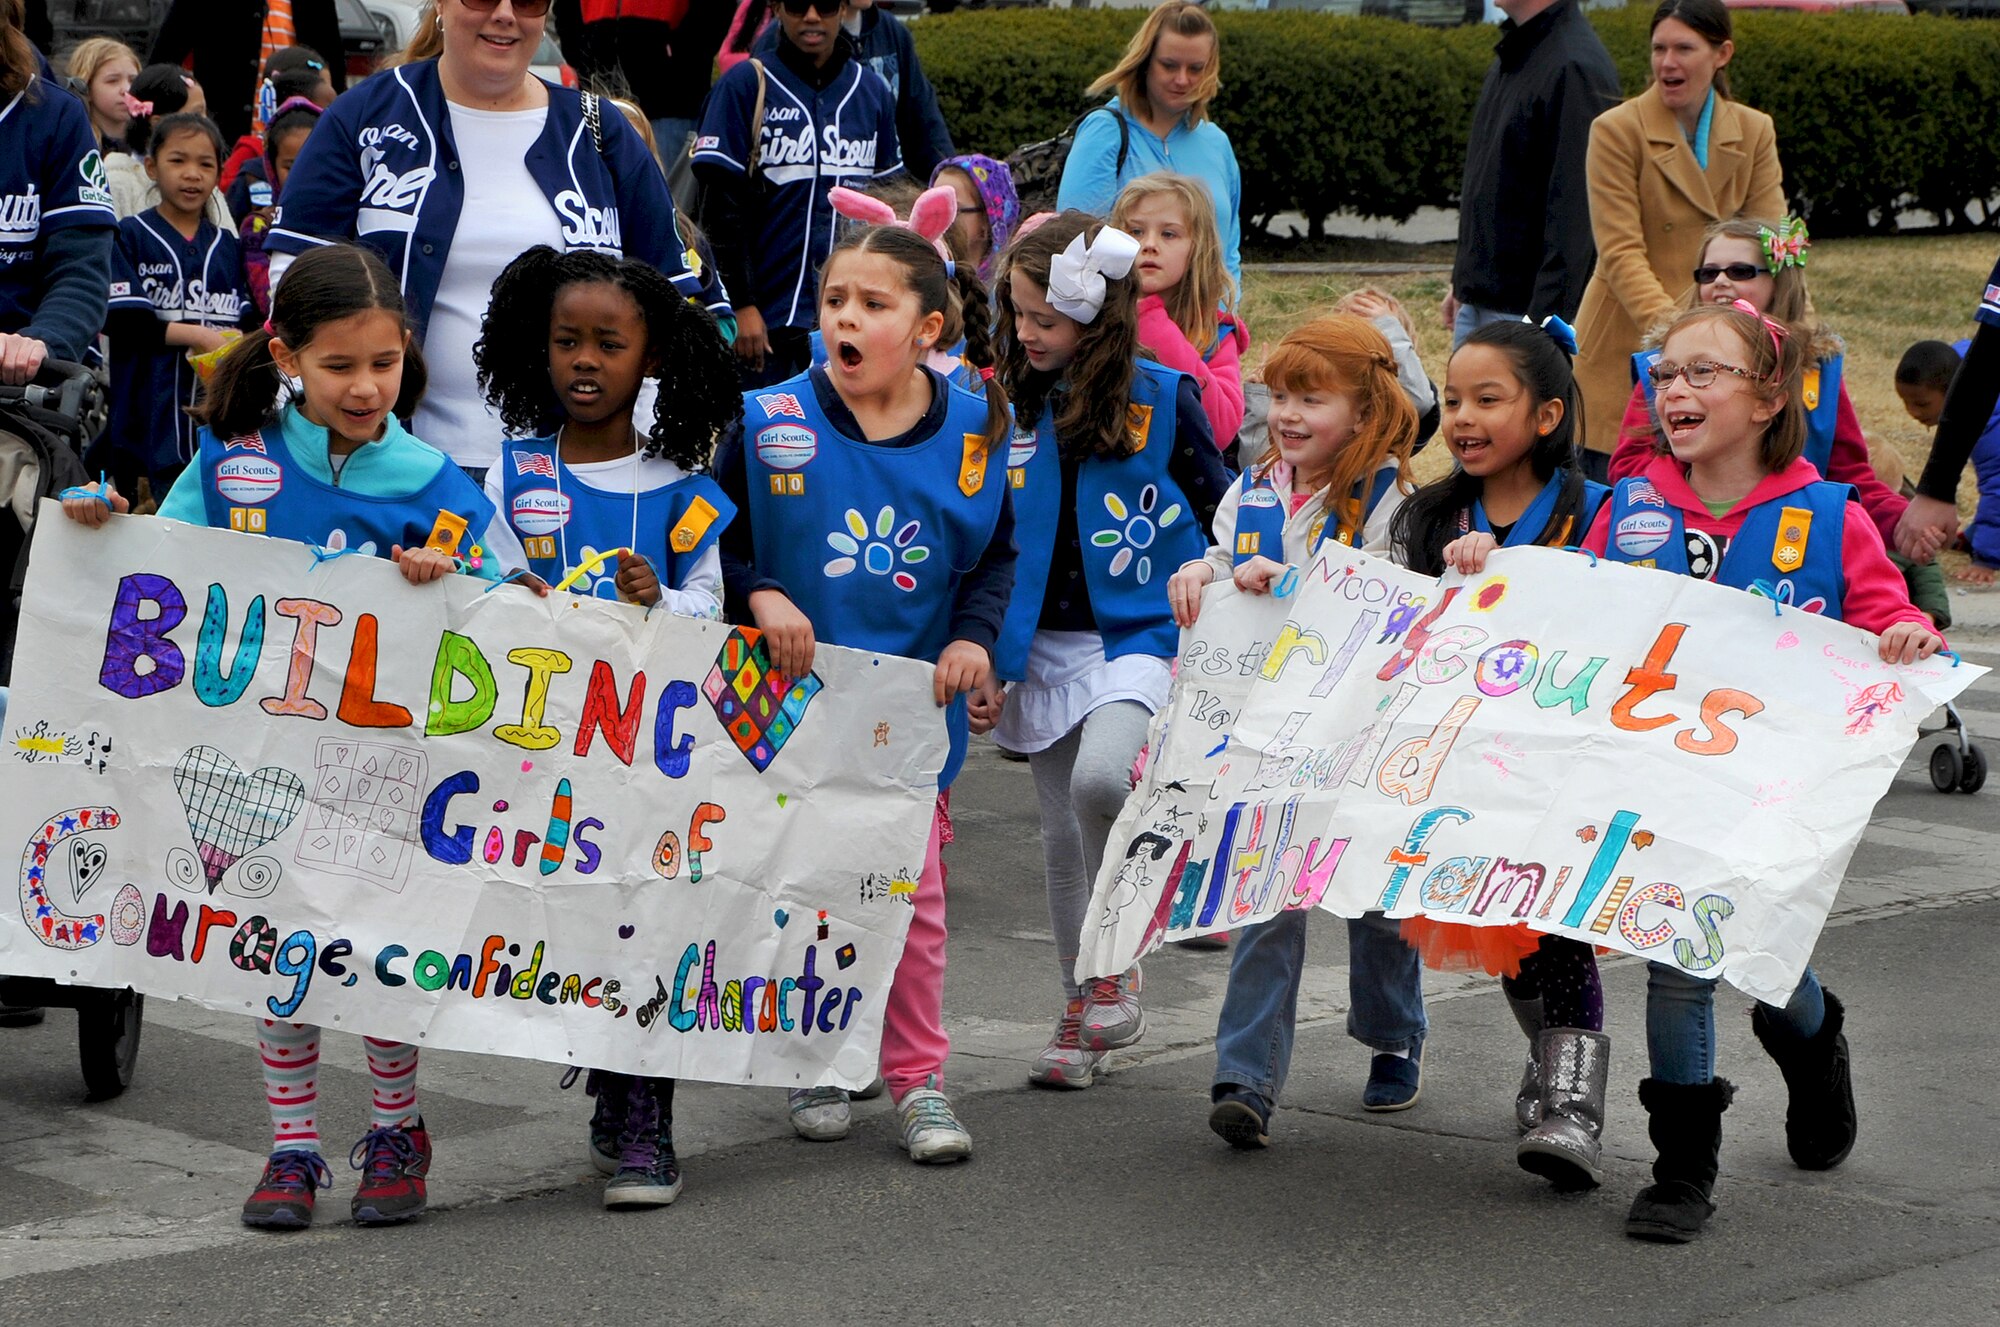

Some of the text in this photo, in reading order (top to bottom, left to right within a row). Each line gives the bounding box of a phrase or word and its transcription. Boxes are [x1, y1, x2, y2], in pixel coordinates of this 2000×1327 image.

[820, 125, 878, 167] Scout
[138, 262, 173, 277] Osan
[761, 433, 778, 443] Girl
[221, 464, 239, 475] Girl
[773, 476, 802, 492] 10
[515, 499, 532, 509] Girl
[1242, 494, 1253, 504] Girl
[233, 511, 263, 529] 10
[1620, 520, 1637, 531] Girl
[527, 538, 552, 556] 10
[1241, 536, 1257, 550] 10
[1257, 610, 1380, 699] rl
[99, 572, 698, 779] BUILDING
[420, 770, 605, 877] Girls
[1376, 806, 1736, 971] families
[635, 975, 668, 1031] and
[668, 939, 863, 1037] Character
